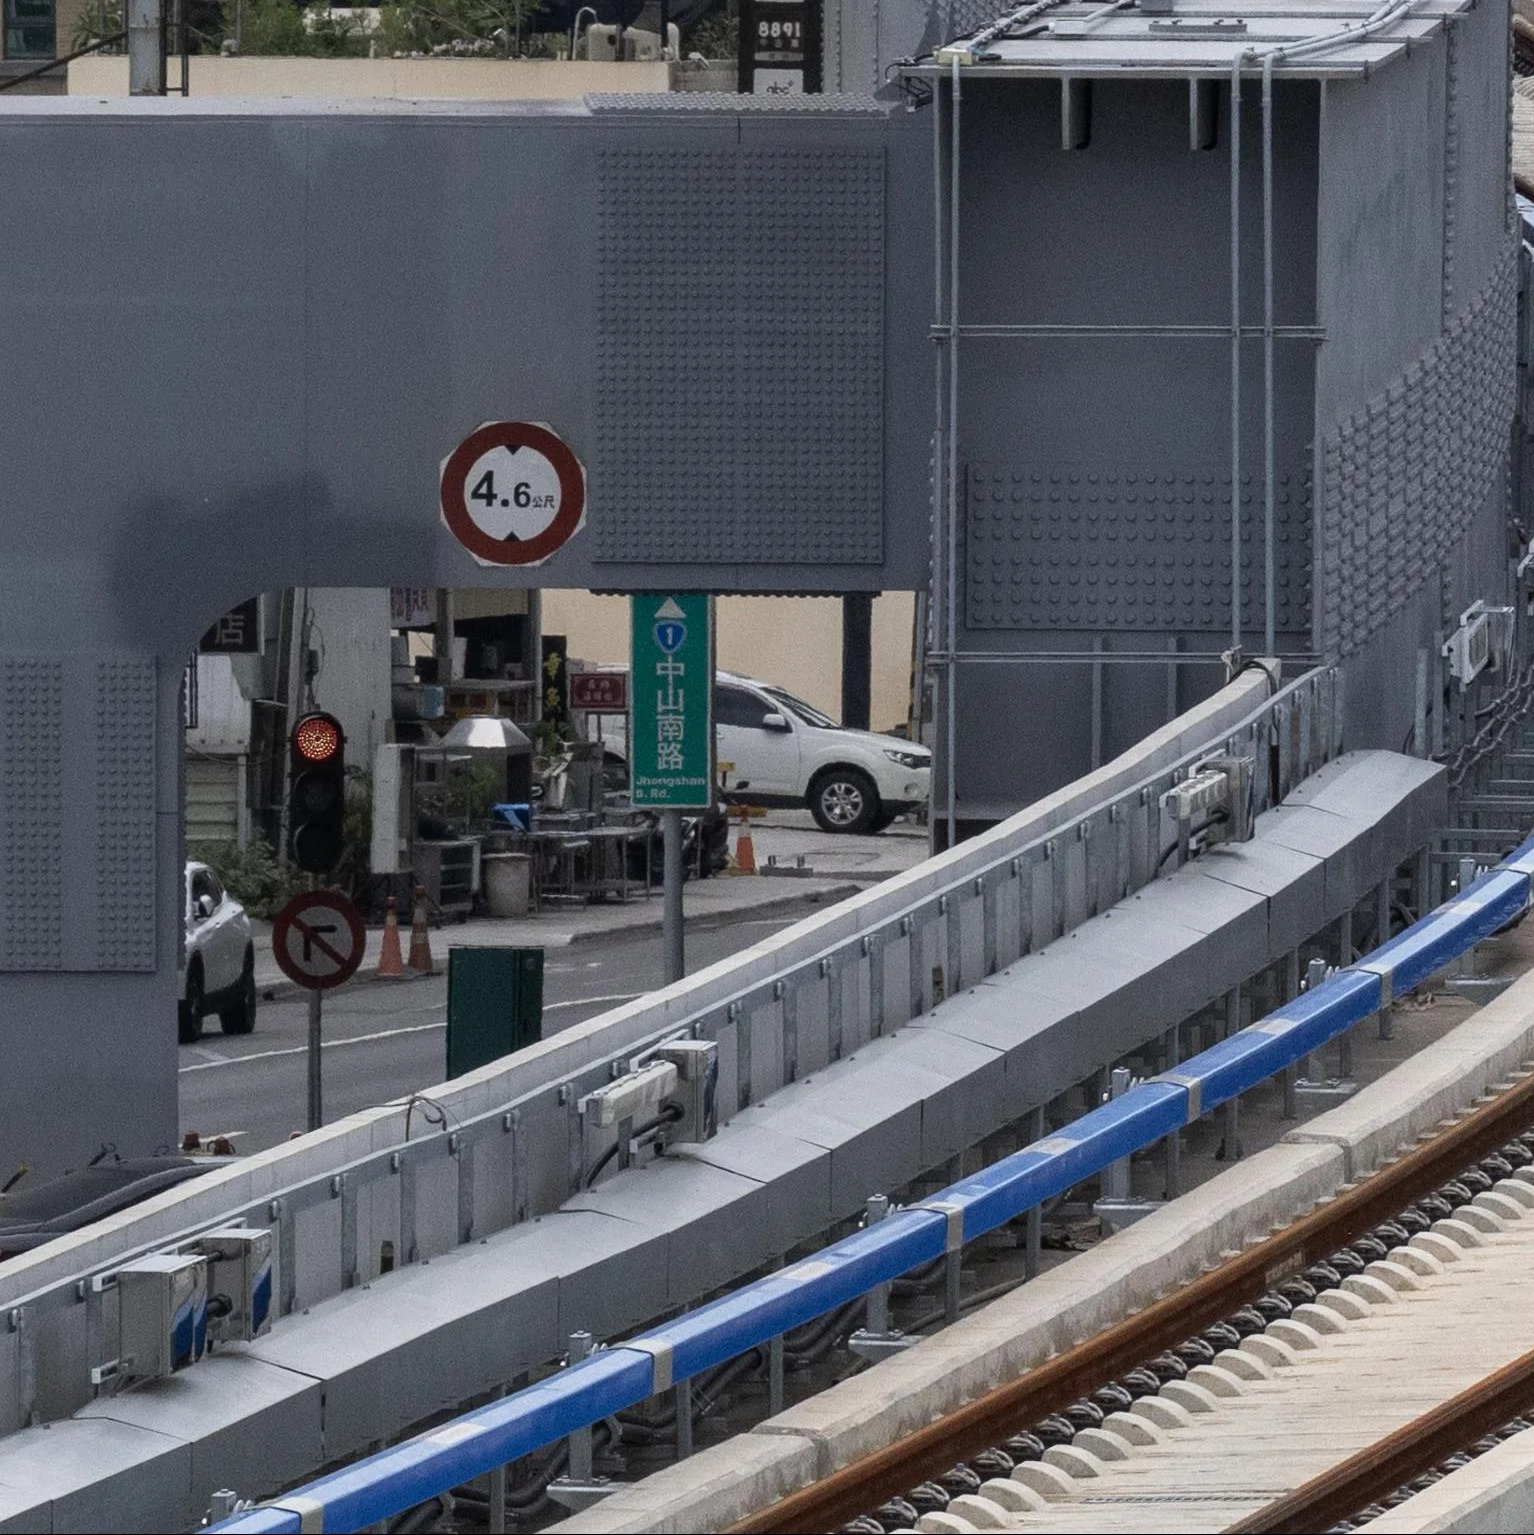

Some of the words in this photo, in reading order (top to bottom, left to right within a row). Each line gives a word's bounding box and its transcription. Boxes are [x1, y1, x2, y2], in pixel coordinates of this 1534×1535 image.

[758, 21, 801, 38] 8891
[656, 654, 686, 771] 中山南路
[636, 776, 706, 787] Jhongshan
[650, 788, 671, 799] Rd.
